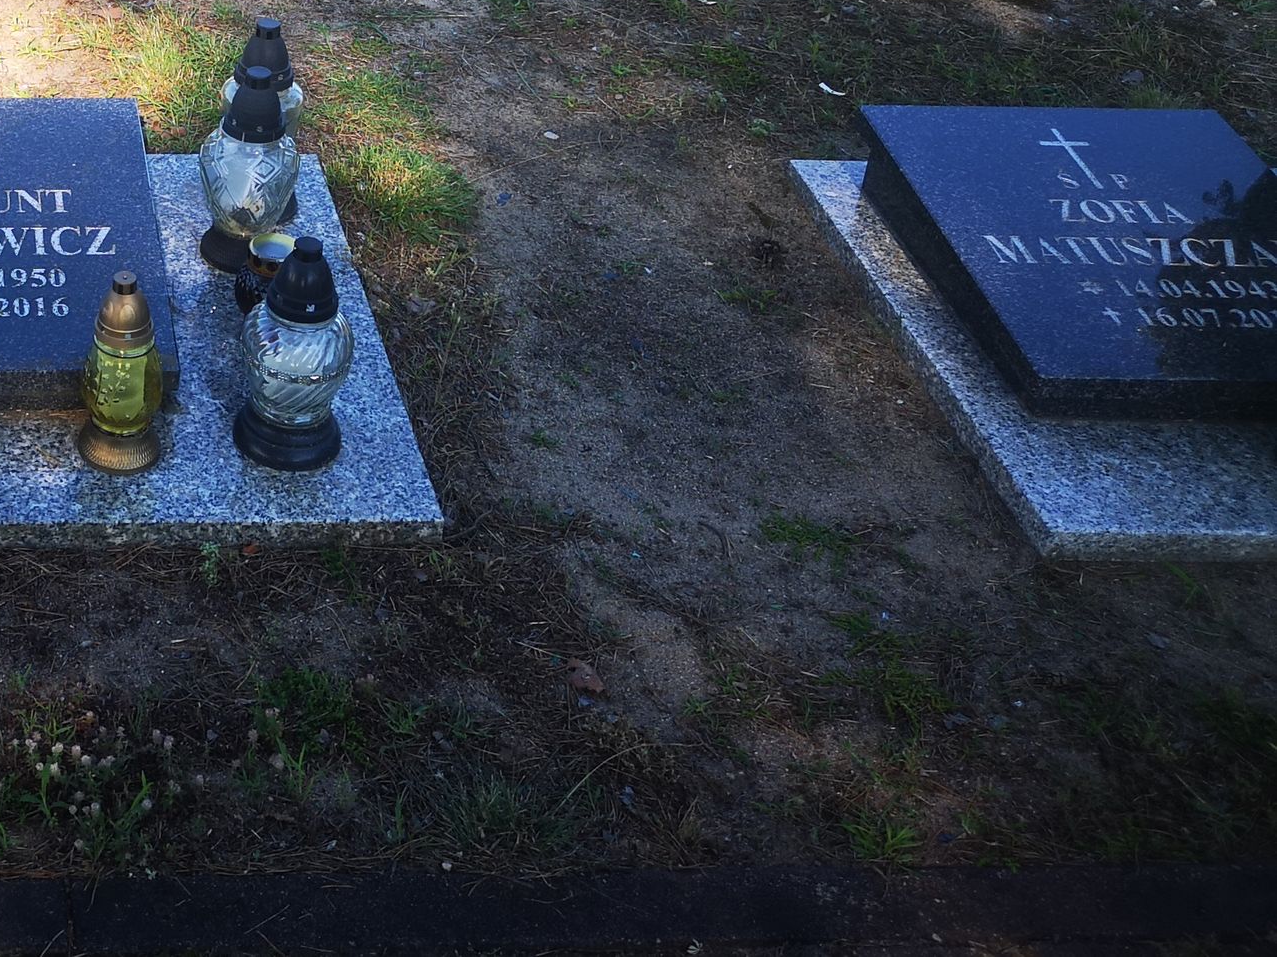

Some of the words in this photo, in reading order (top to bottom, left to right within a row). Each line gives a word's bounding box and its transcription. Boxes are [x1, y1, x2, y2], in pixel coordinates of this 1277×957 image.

[1048, 198, 1196, 225] ZOFIA
[982, 235, 1277, 268] MATUSZCZA
[1135, 306, 1277, 329] 16.07.20
